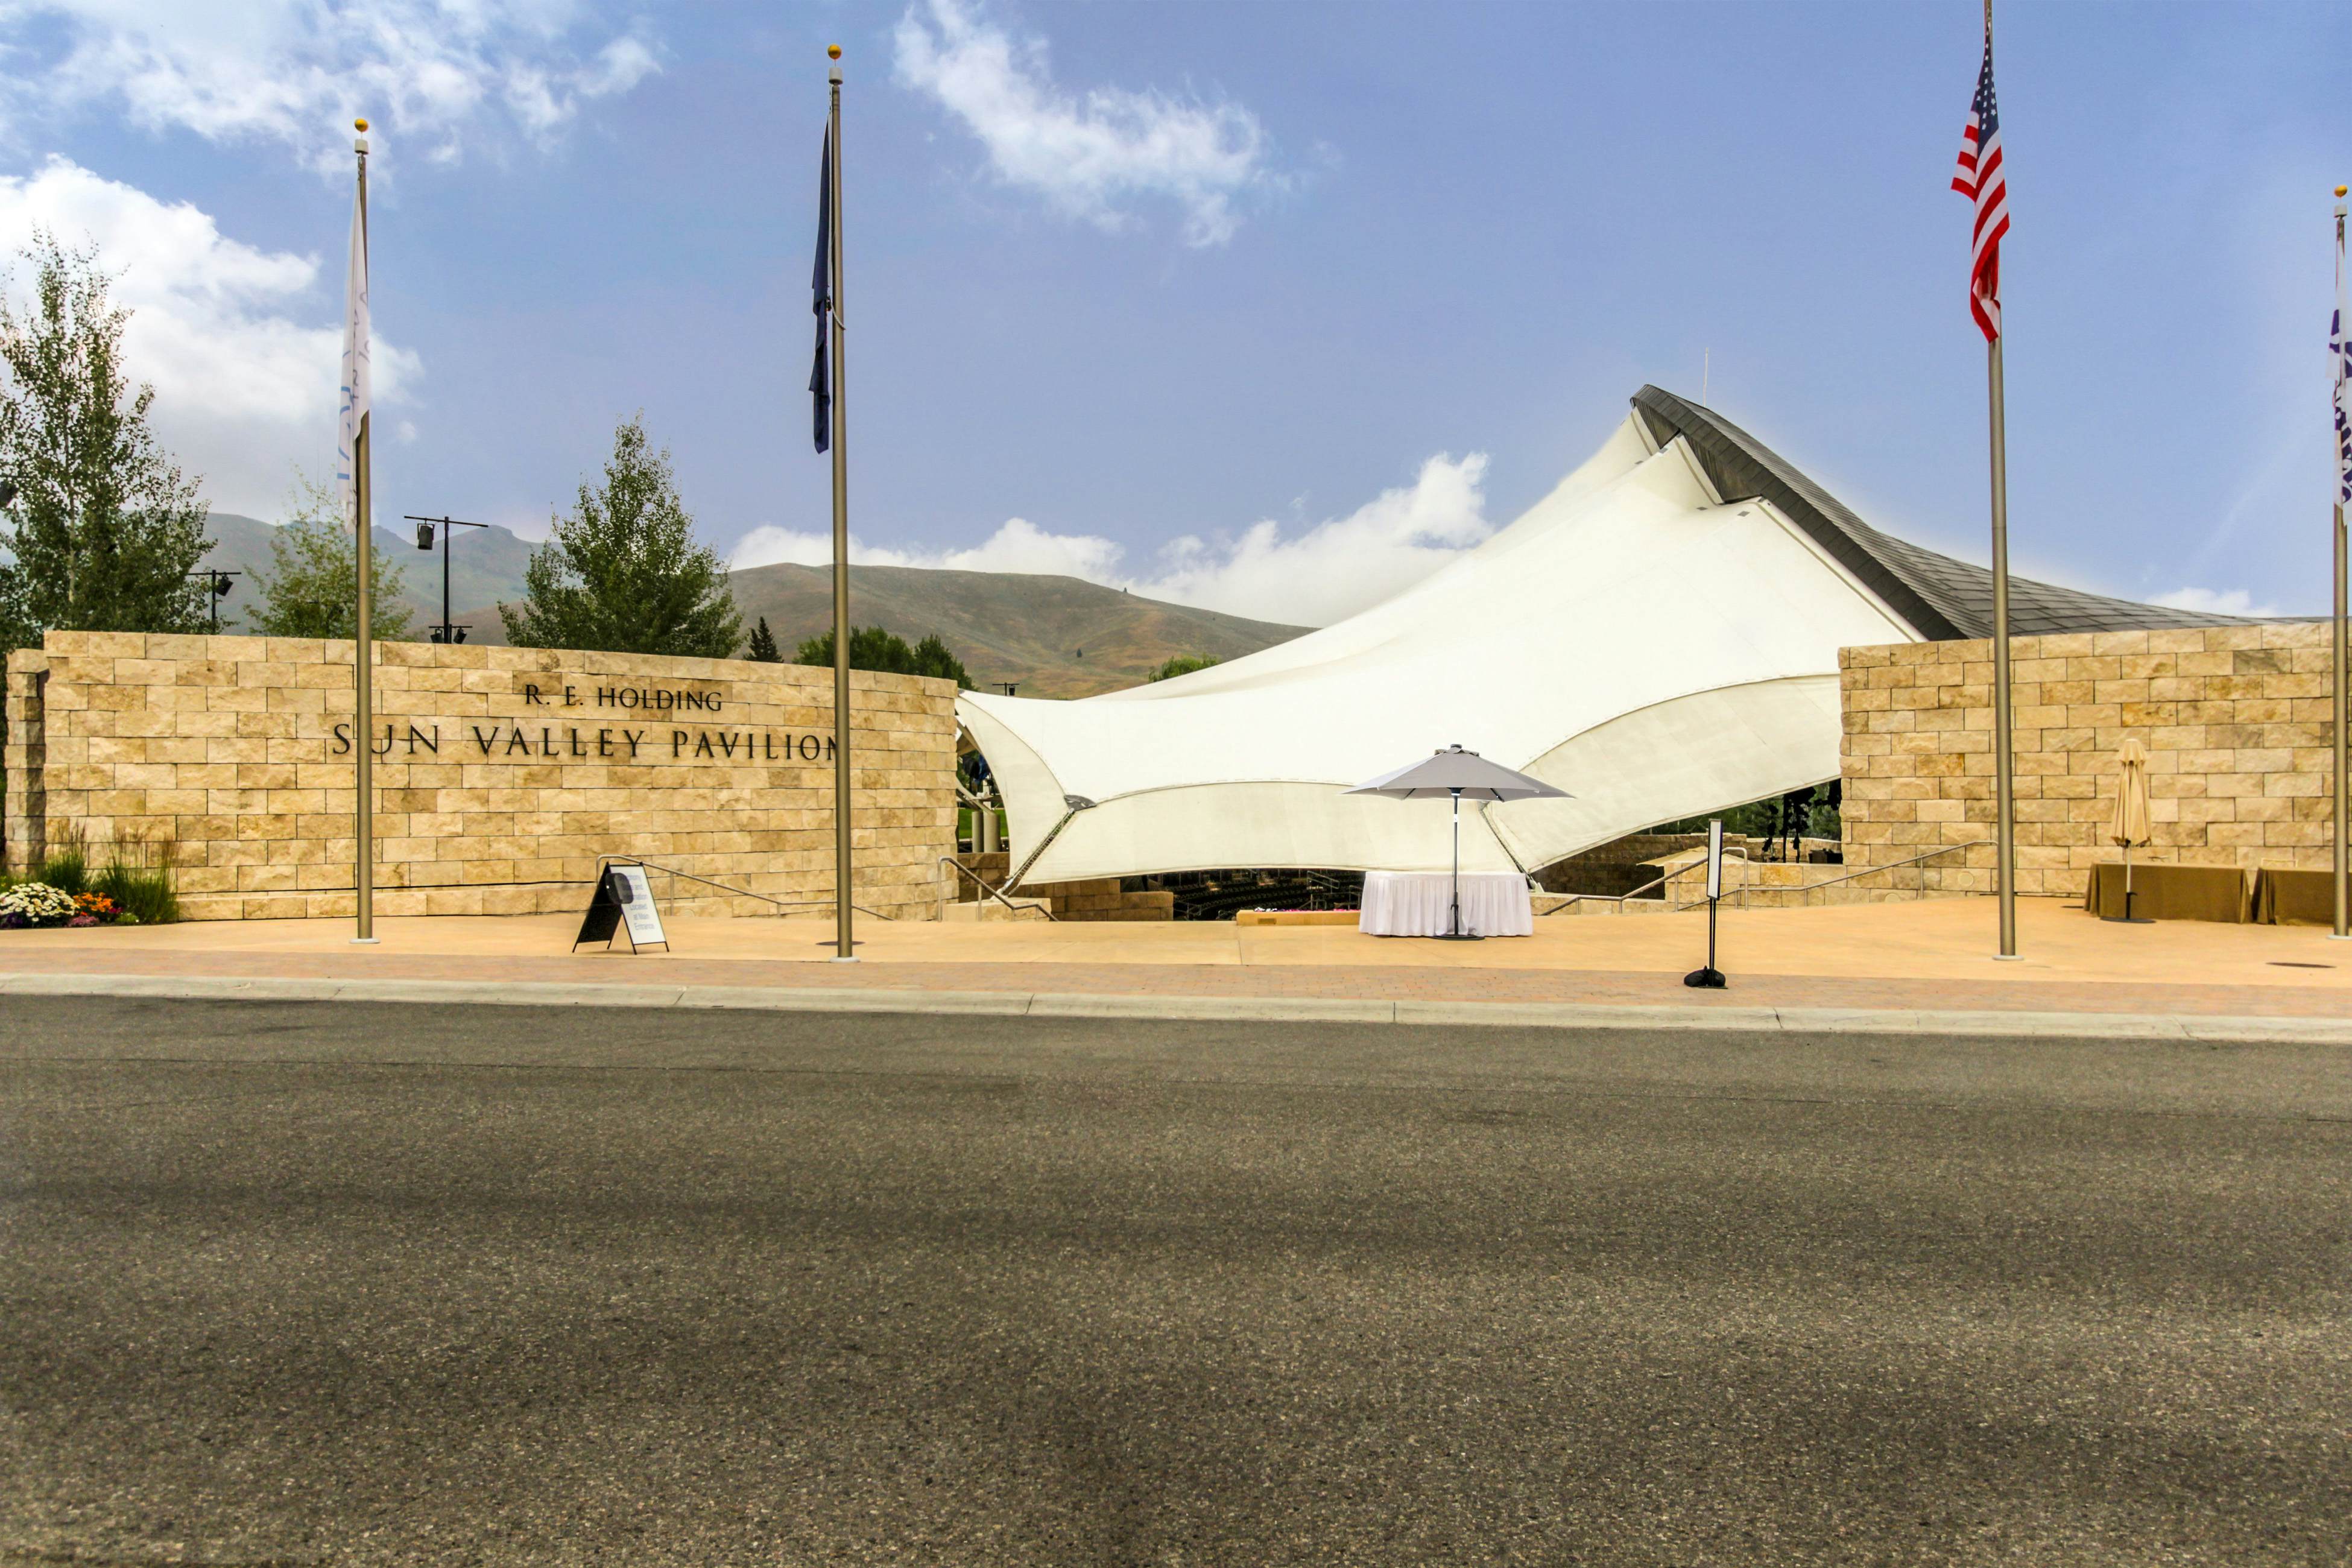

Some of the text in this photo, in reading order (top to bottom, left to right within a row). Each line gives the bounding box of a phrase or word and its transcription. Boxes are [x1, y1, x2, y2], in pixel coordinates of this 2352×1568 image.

[526, 684, 722, 712] R. E. HOLDING
[333, 724, 438, 754] SUN
[472, 726, 645, 757] VALLEY
